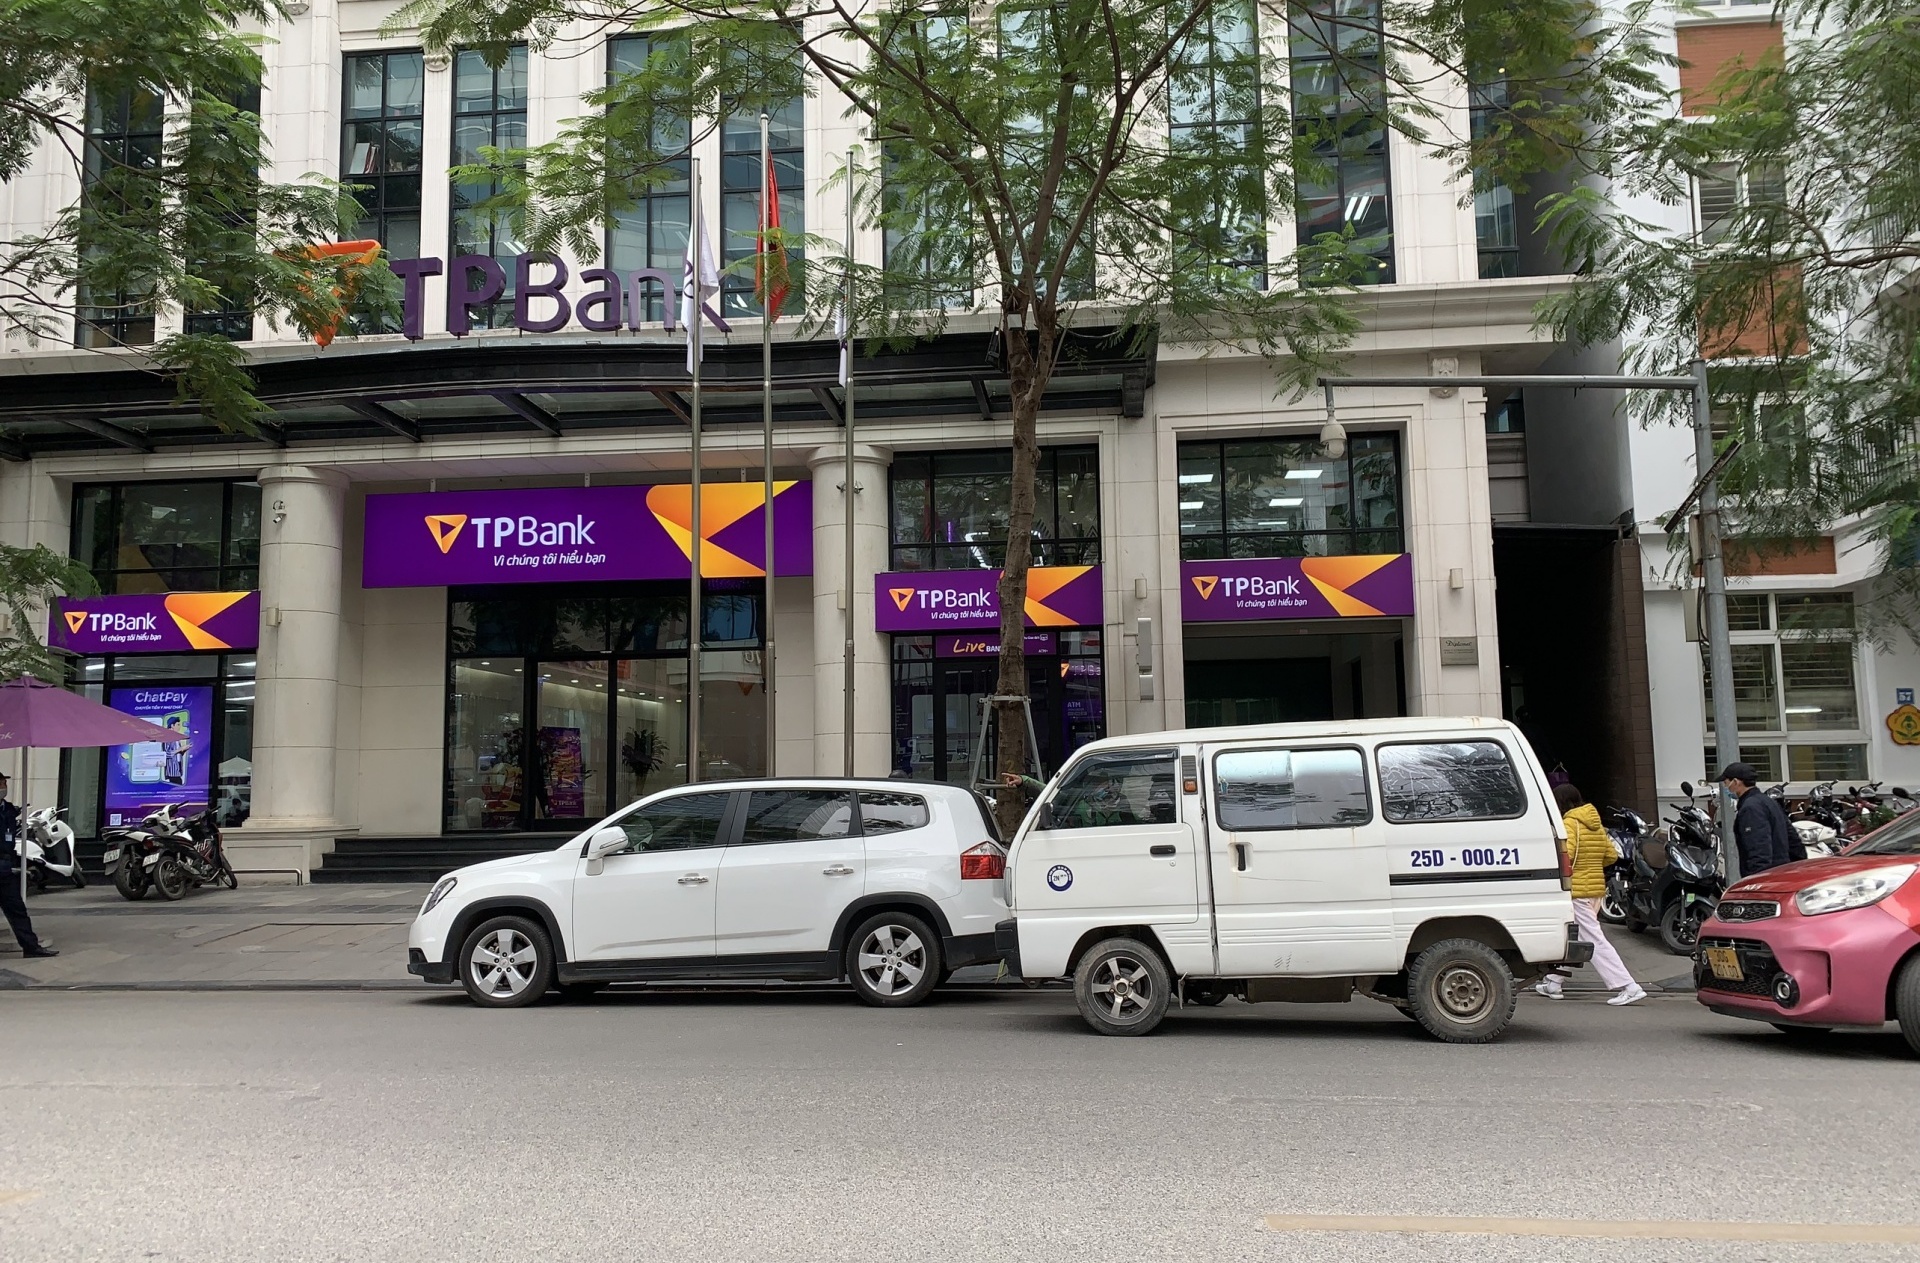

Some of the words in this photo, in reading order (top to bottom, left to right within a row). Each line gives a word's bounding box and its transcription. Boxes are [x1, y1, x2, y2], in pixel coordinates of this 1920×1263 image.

[471, 514, 596, 548] TPBank
[493, 554, 505, 567] Vì
[506, 553, 540, 568] chúng
[542, 553, 557, 565] tôi
[559, 549, 583, 564] hiểu
[585, 553, 606, 566] bạn
[1221, 575, 1300, 597] TPBank
[917, 588, 991, 609] TPBank
[1236, 600, 1244, 608] Vì
[1245, 599, 1266, 609] chúng
[1267, 598, 1277, 607] tôi
[1278, 596, 1294, 606] hiểu
[1295, 598, 1308, 607] bạn
[89, 612, 157, 632] TPBank
[931, 612, 939, 620] Vì
[940, 611, 958, 621] chúng
[960, 611, 969, 619] tôi
[970, 608, 984, 618] hiểu
[984, 610, 998, 620] bạn
[108, 634, 126, 644] chúng
[136, 632, 149, 641] hiểu
[150, 634, 162, 642] bạn
[953, 638, 986, 653] Live
[135, 691, 188, 704] ChatPay
[1411, 850, 1444, 868] 25D
[1462, 848, 1520, 866] 000.21
